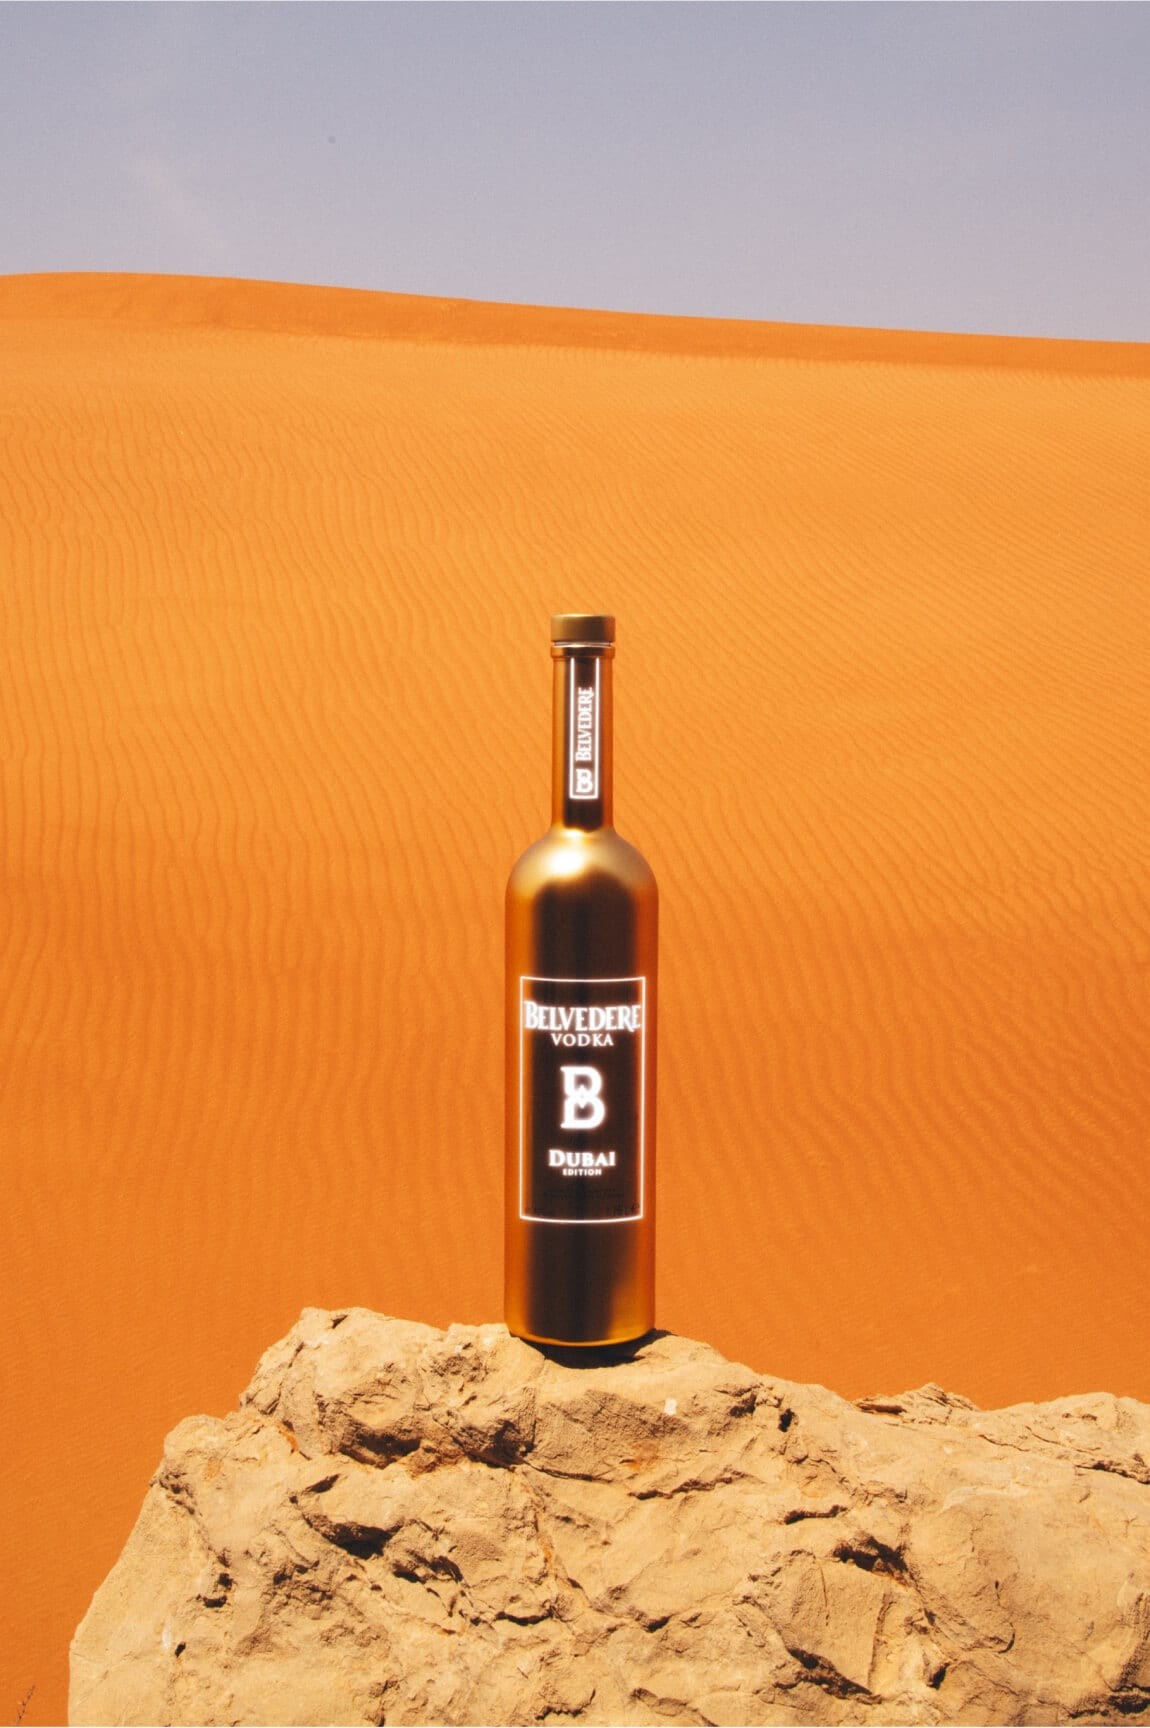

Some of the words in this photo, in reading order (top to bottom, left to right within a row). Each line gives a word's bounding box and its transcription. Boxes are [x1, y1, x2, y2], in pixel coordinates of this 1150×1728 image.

[575, 687, 594, 761] BELVEDERE
[524, 1000, 641, 1032] BELVEDERE
[551, 1033, 614, 1047] VODKA
[549, 1149, 616, 1168] DUBAI
[562, 1168, 602, 1176] EDITION
